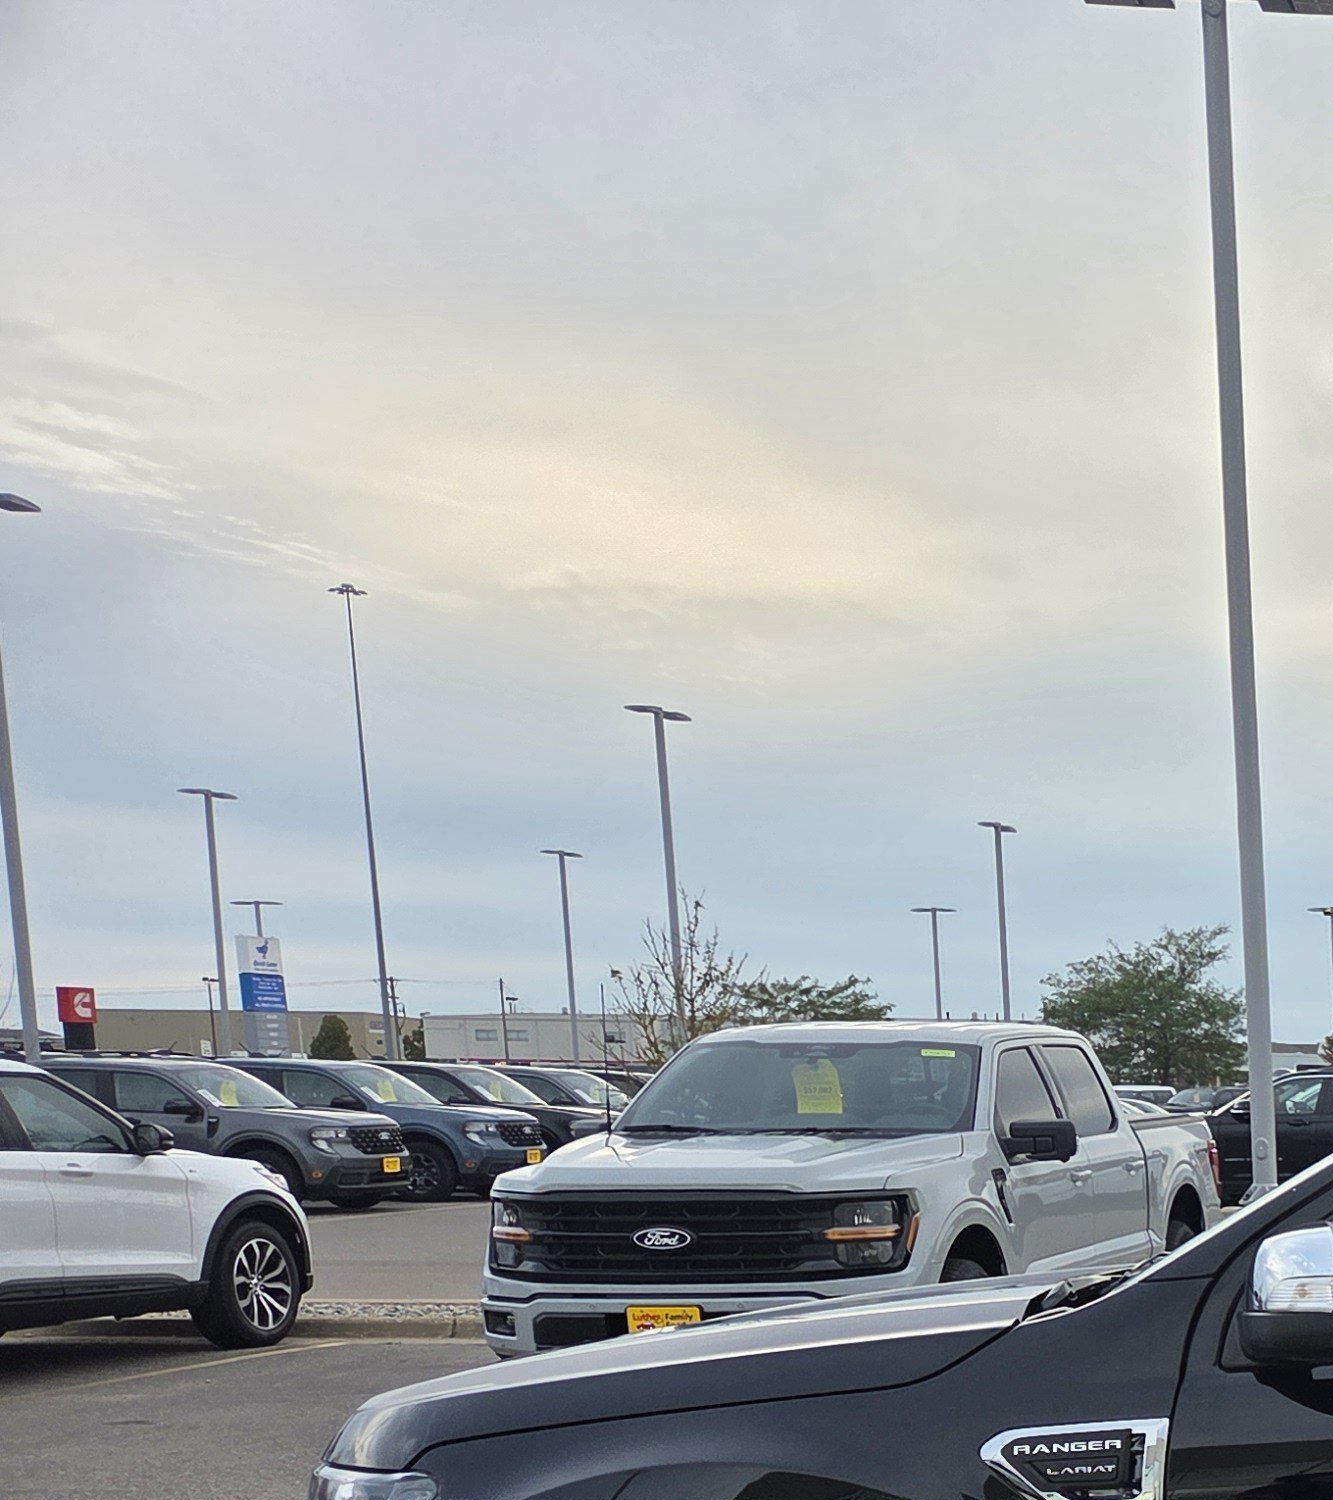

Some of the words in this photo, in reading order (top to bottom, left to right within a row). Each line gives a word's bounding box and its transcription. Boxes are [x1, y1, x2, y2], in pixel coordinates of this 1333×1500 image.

[643, 1229, 680, 1246] Ford
[665, 1313, 693, 1322] Family
[1012, 1438, 1122, 1456] RANGER
[1045, 1463, 1117, 1476] LARIAT
